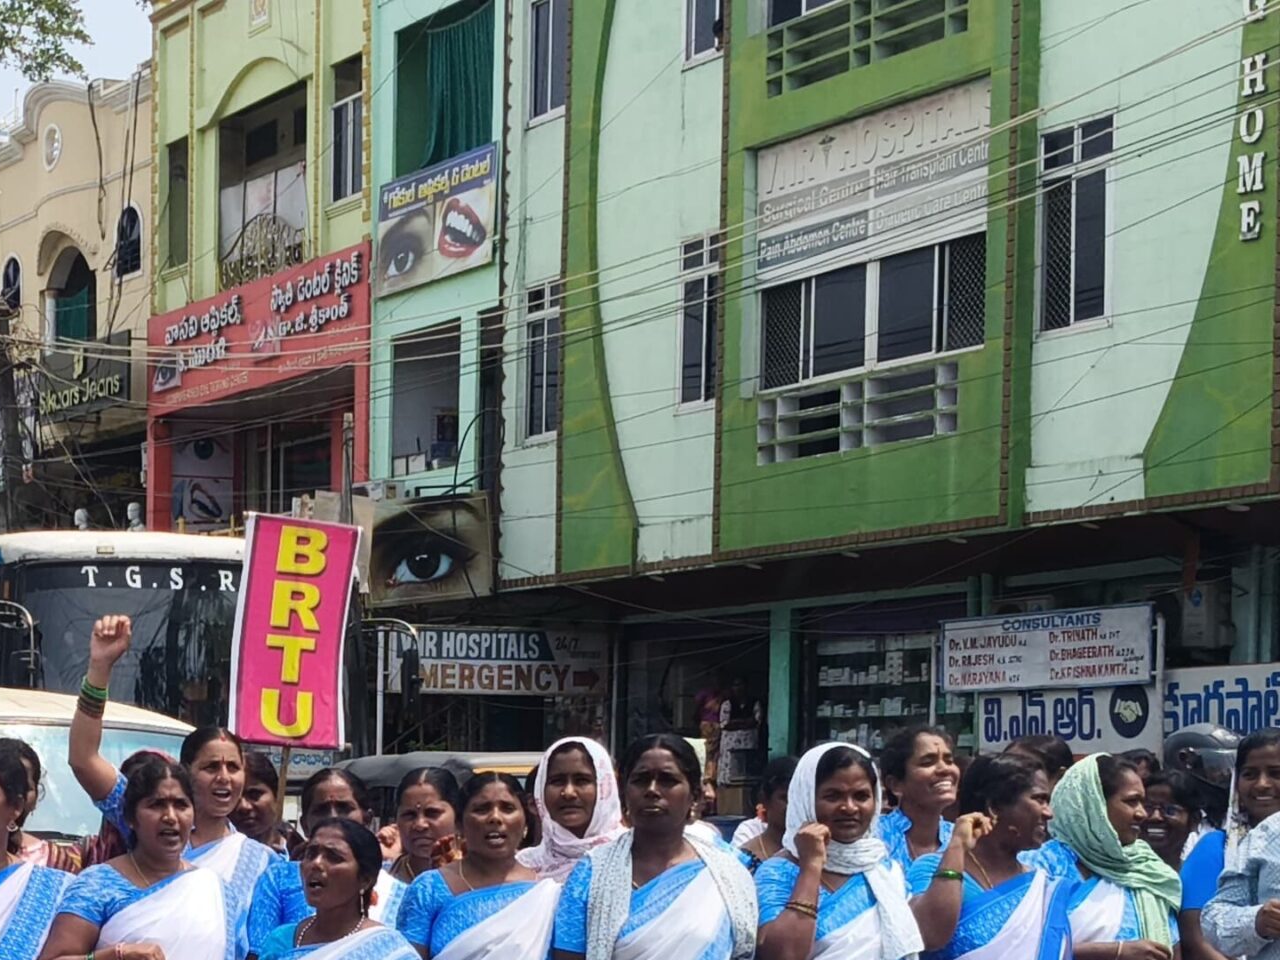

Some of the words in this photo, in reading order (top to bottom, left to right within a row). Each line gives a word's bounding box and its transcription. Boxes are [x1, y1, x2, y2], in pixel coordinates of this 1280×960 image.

[958, 140, 990, 166] Centr
[1236, 53, 1267, 241] HOME
[82, 375, 120, 402] Jeans
[260, 525, 328, 738] BRTU
[1001, 612, 1102, 632] CONSULTANTS
[441, 631, 540, 659] HOSPITALS
[418, 663, 571, 692] MERGENCY
